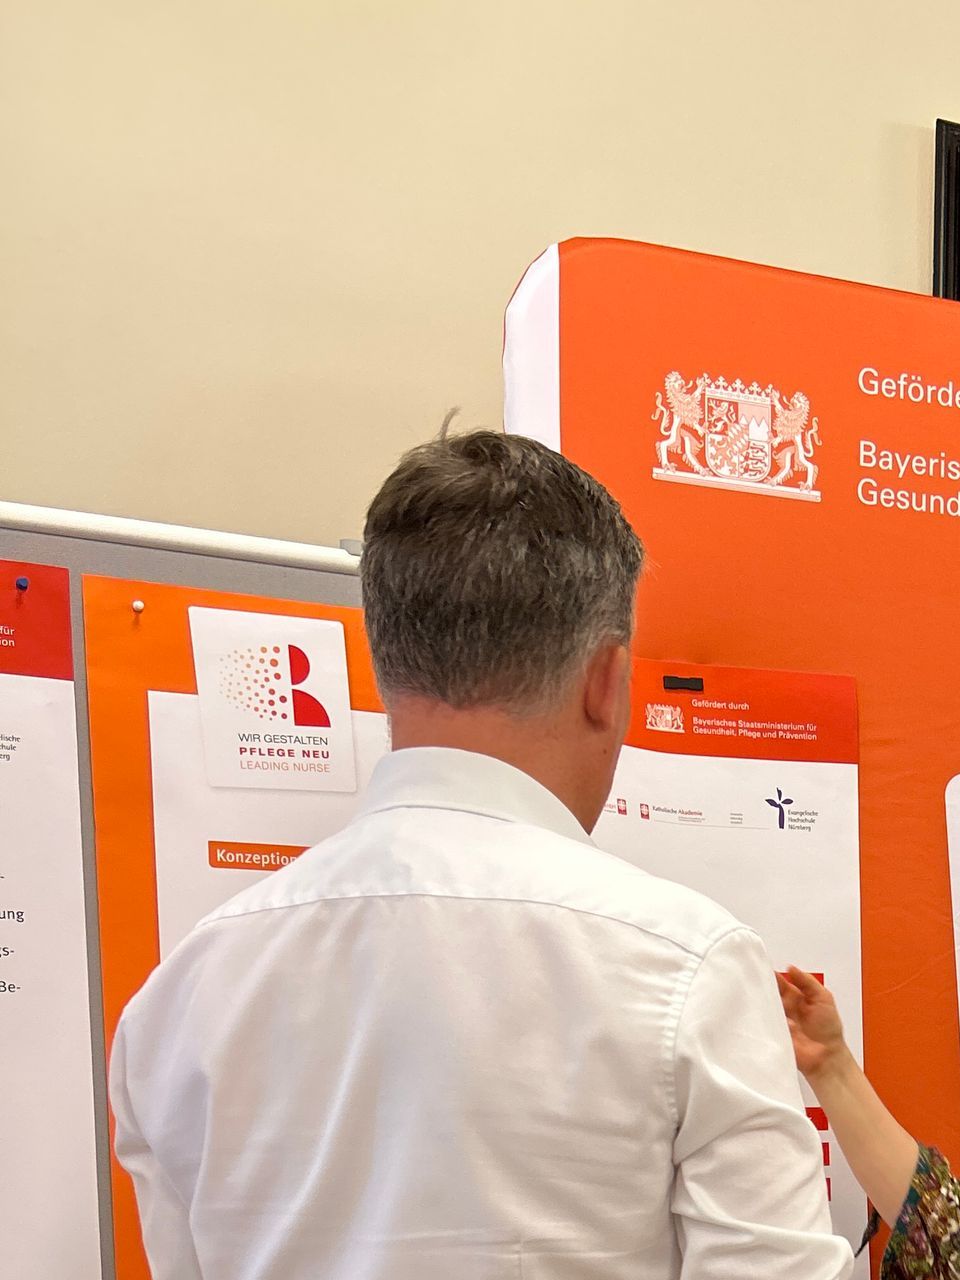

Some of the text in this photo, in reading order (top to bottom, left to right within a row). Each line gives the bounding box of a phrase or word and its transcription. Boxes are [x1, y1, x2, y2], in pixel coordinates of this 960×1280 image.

[691, 699, 750, 710] Gefördert durch
[692, 717, 817, 732] Bayerisches Staatsministerium für
[238, 733, 328, 746] WIR GESTALTEN
[738, 728, 761, 739] Pflege
[778, 731, 817, 741] Prävention
[239, 747, 330, 759] PFLEGE NEU
[240, 760, 331, 773] LEADING NURSE
